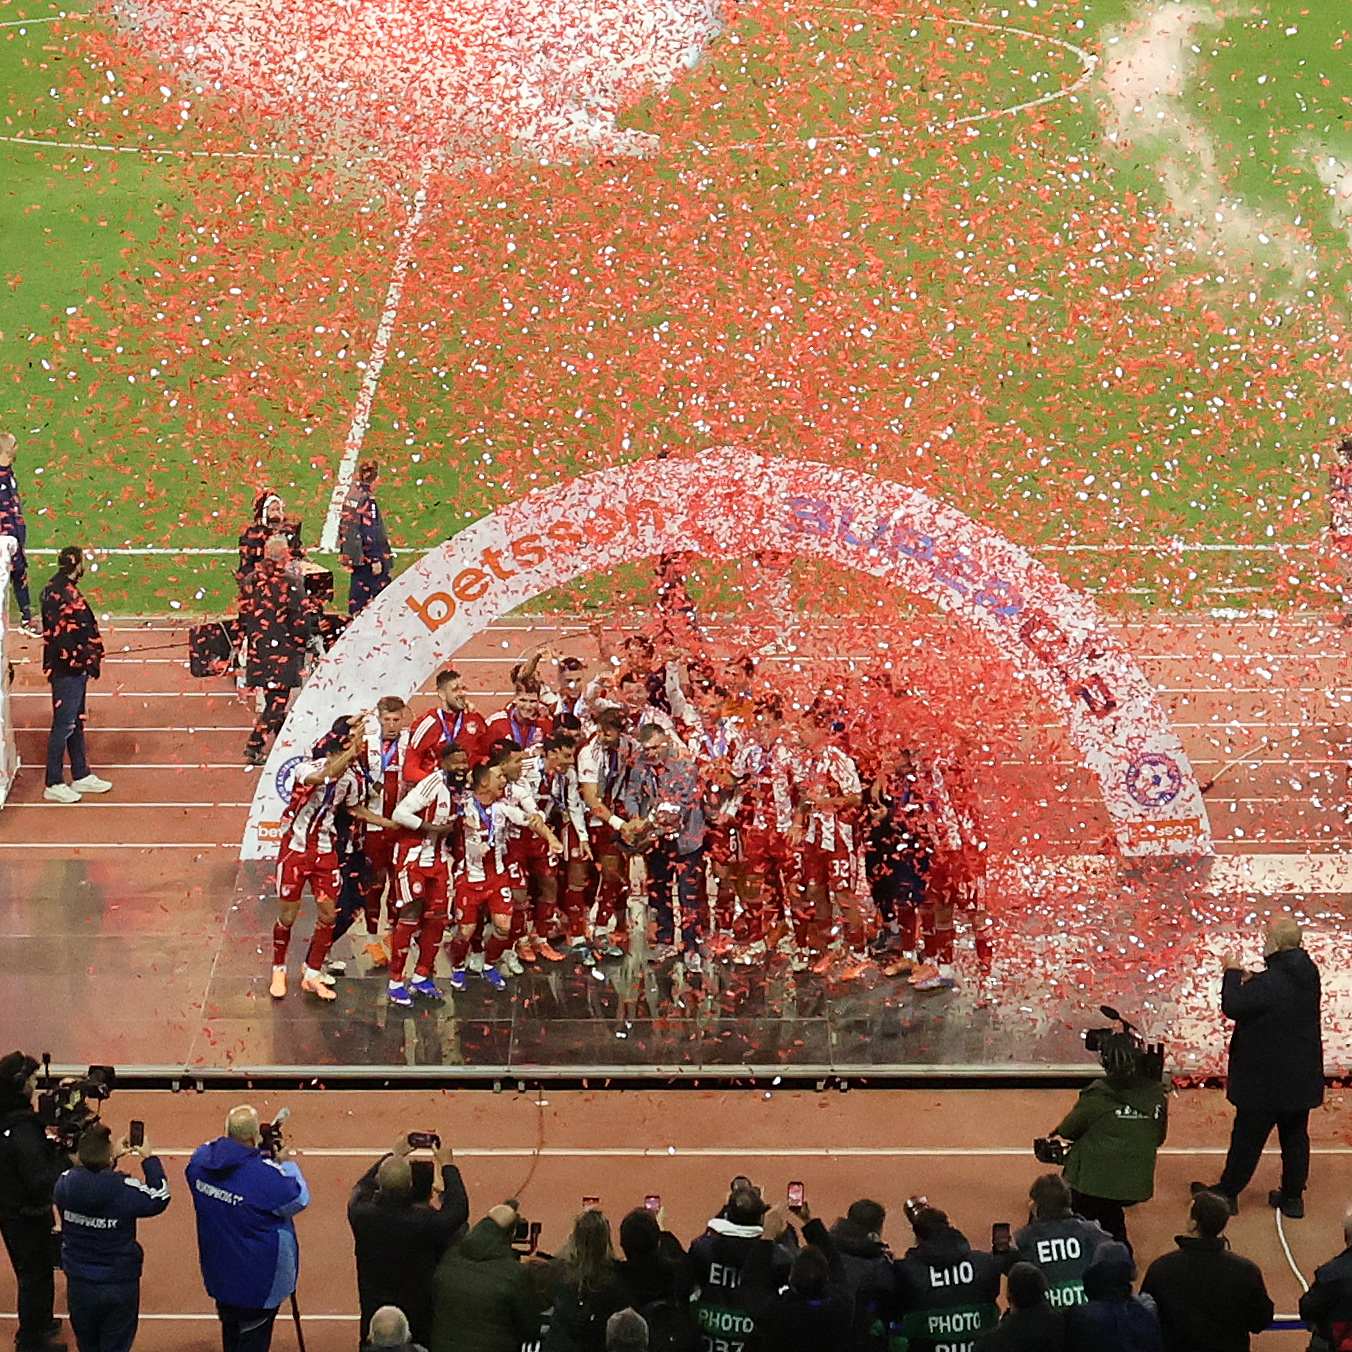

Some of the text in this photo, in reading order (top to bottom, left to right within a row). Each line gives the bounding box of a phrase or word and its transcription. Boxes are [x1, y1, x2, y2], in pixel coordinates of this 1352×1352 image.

[406, 497, 664, 632] betsson
[832, 859, 850, 877] 32
[500, 887, 512, 903] 9
[1036, 1237, 1081, 1263] ΕΠΟ
[709, 1261, 741, 1289] ΕΠ
[1045, 1285, 1089, 1308] HOT
[699, 1308, 755, 1334] PHOTO
